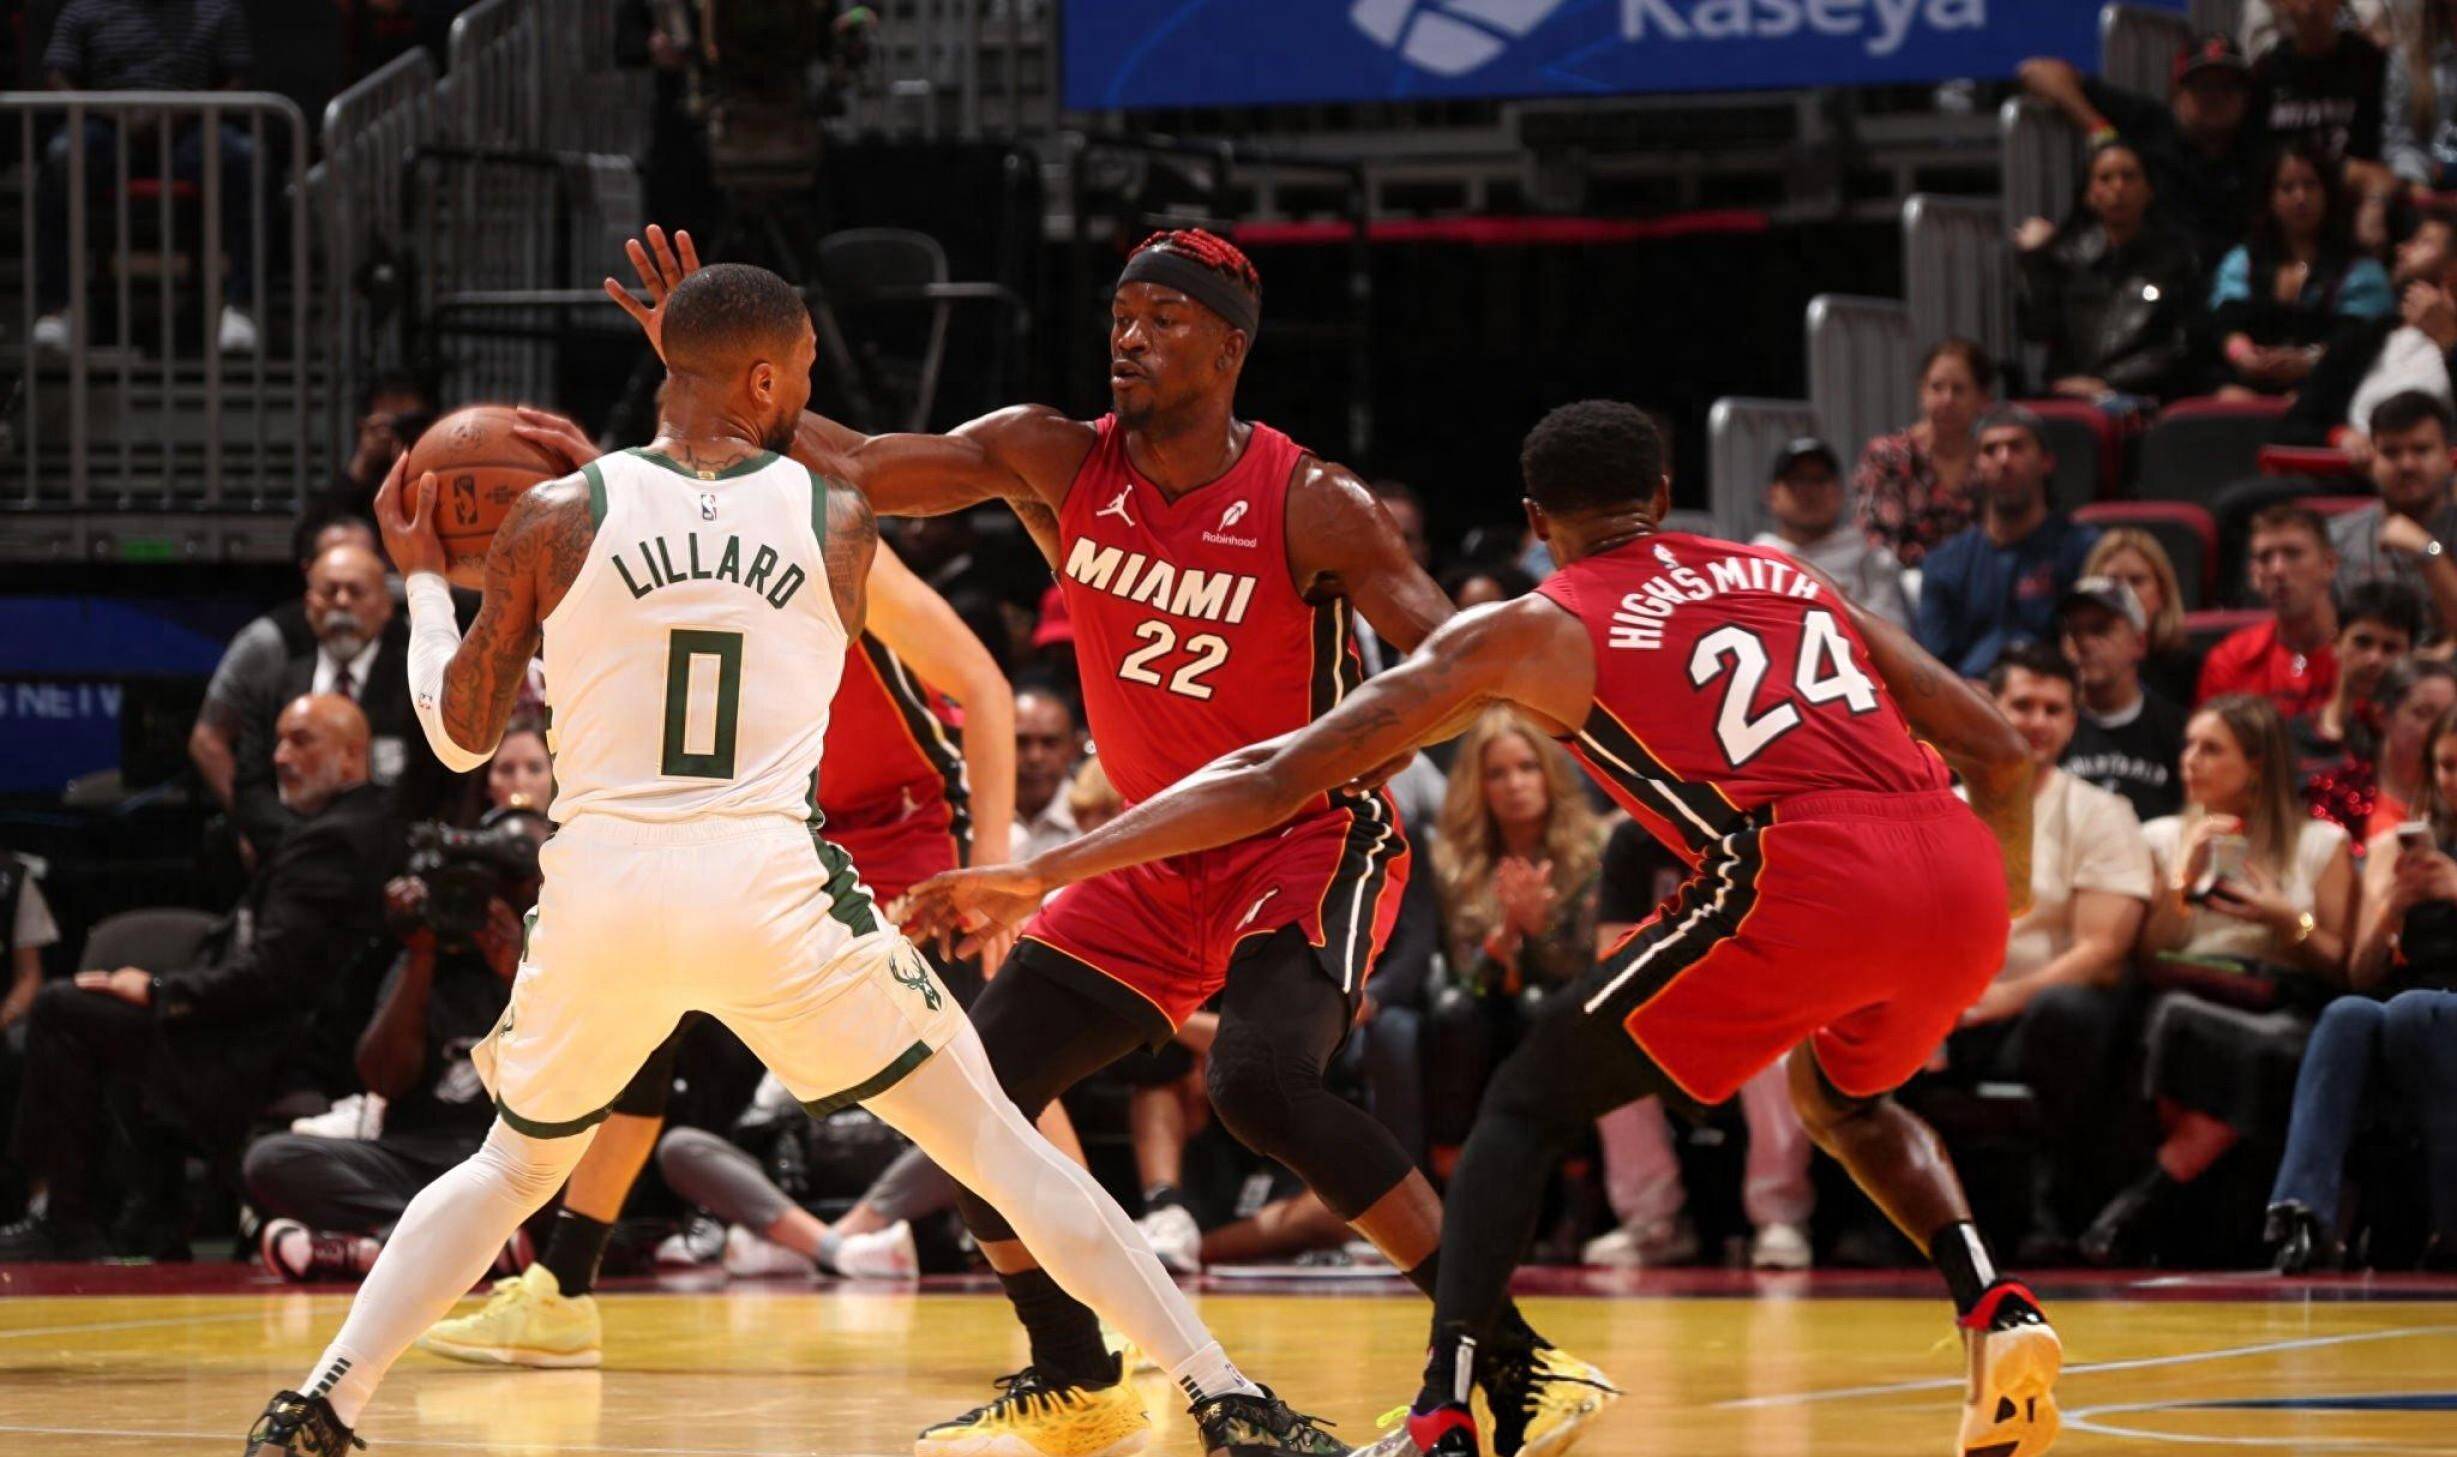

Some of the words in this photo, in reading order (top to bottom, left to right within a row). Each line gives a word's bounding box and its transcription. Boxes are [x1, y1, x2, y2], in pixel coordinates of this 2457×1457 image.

[1622, 0, 1985, 56] Kaseya
[612, 532, 805, 610] LILLARD
[1065, 536, 1257, 624] MIAMI
[1202, 531, 1257, 548] Robinhood
[1608, 556, 1820, 649] HIGHSMITH
[1118, 619, 1229, 699] 22
[1688, 608, 1879, 769] 24
[661, 628, 743, 780] 0
